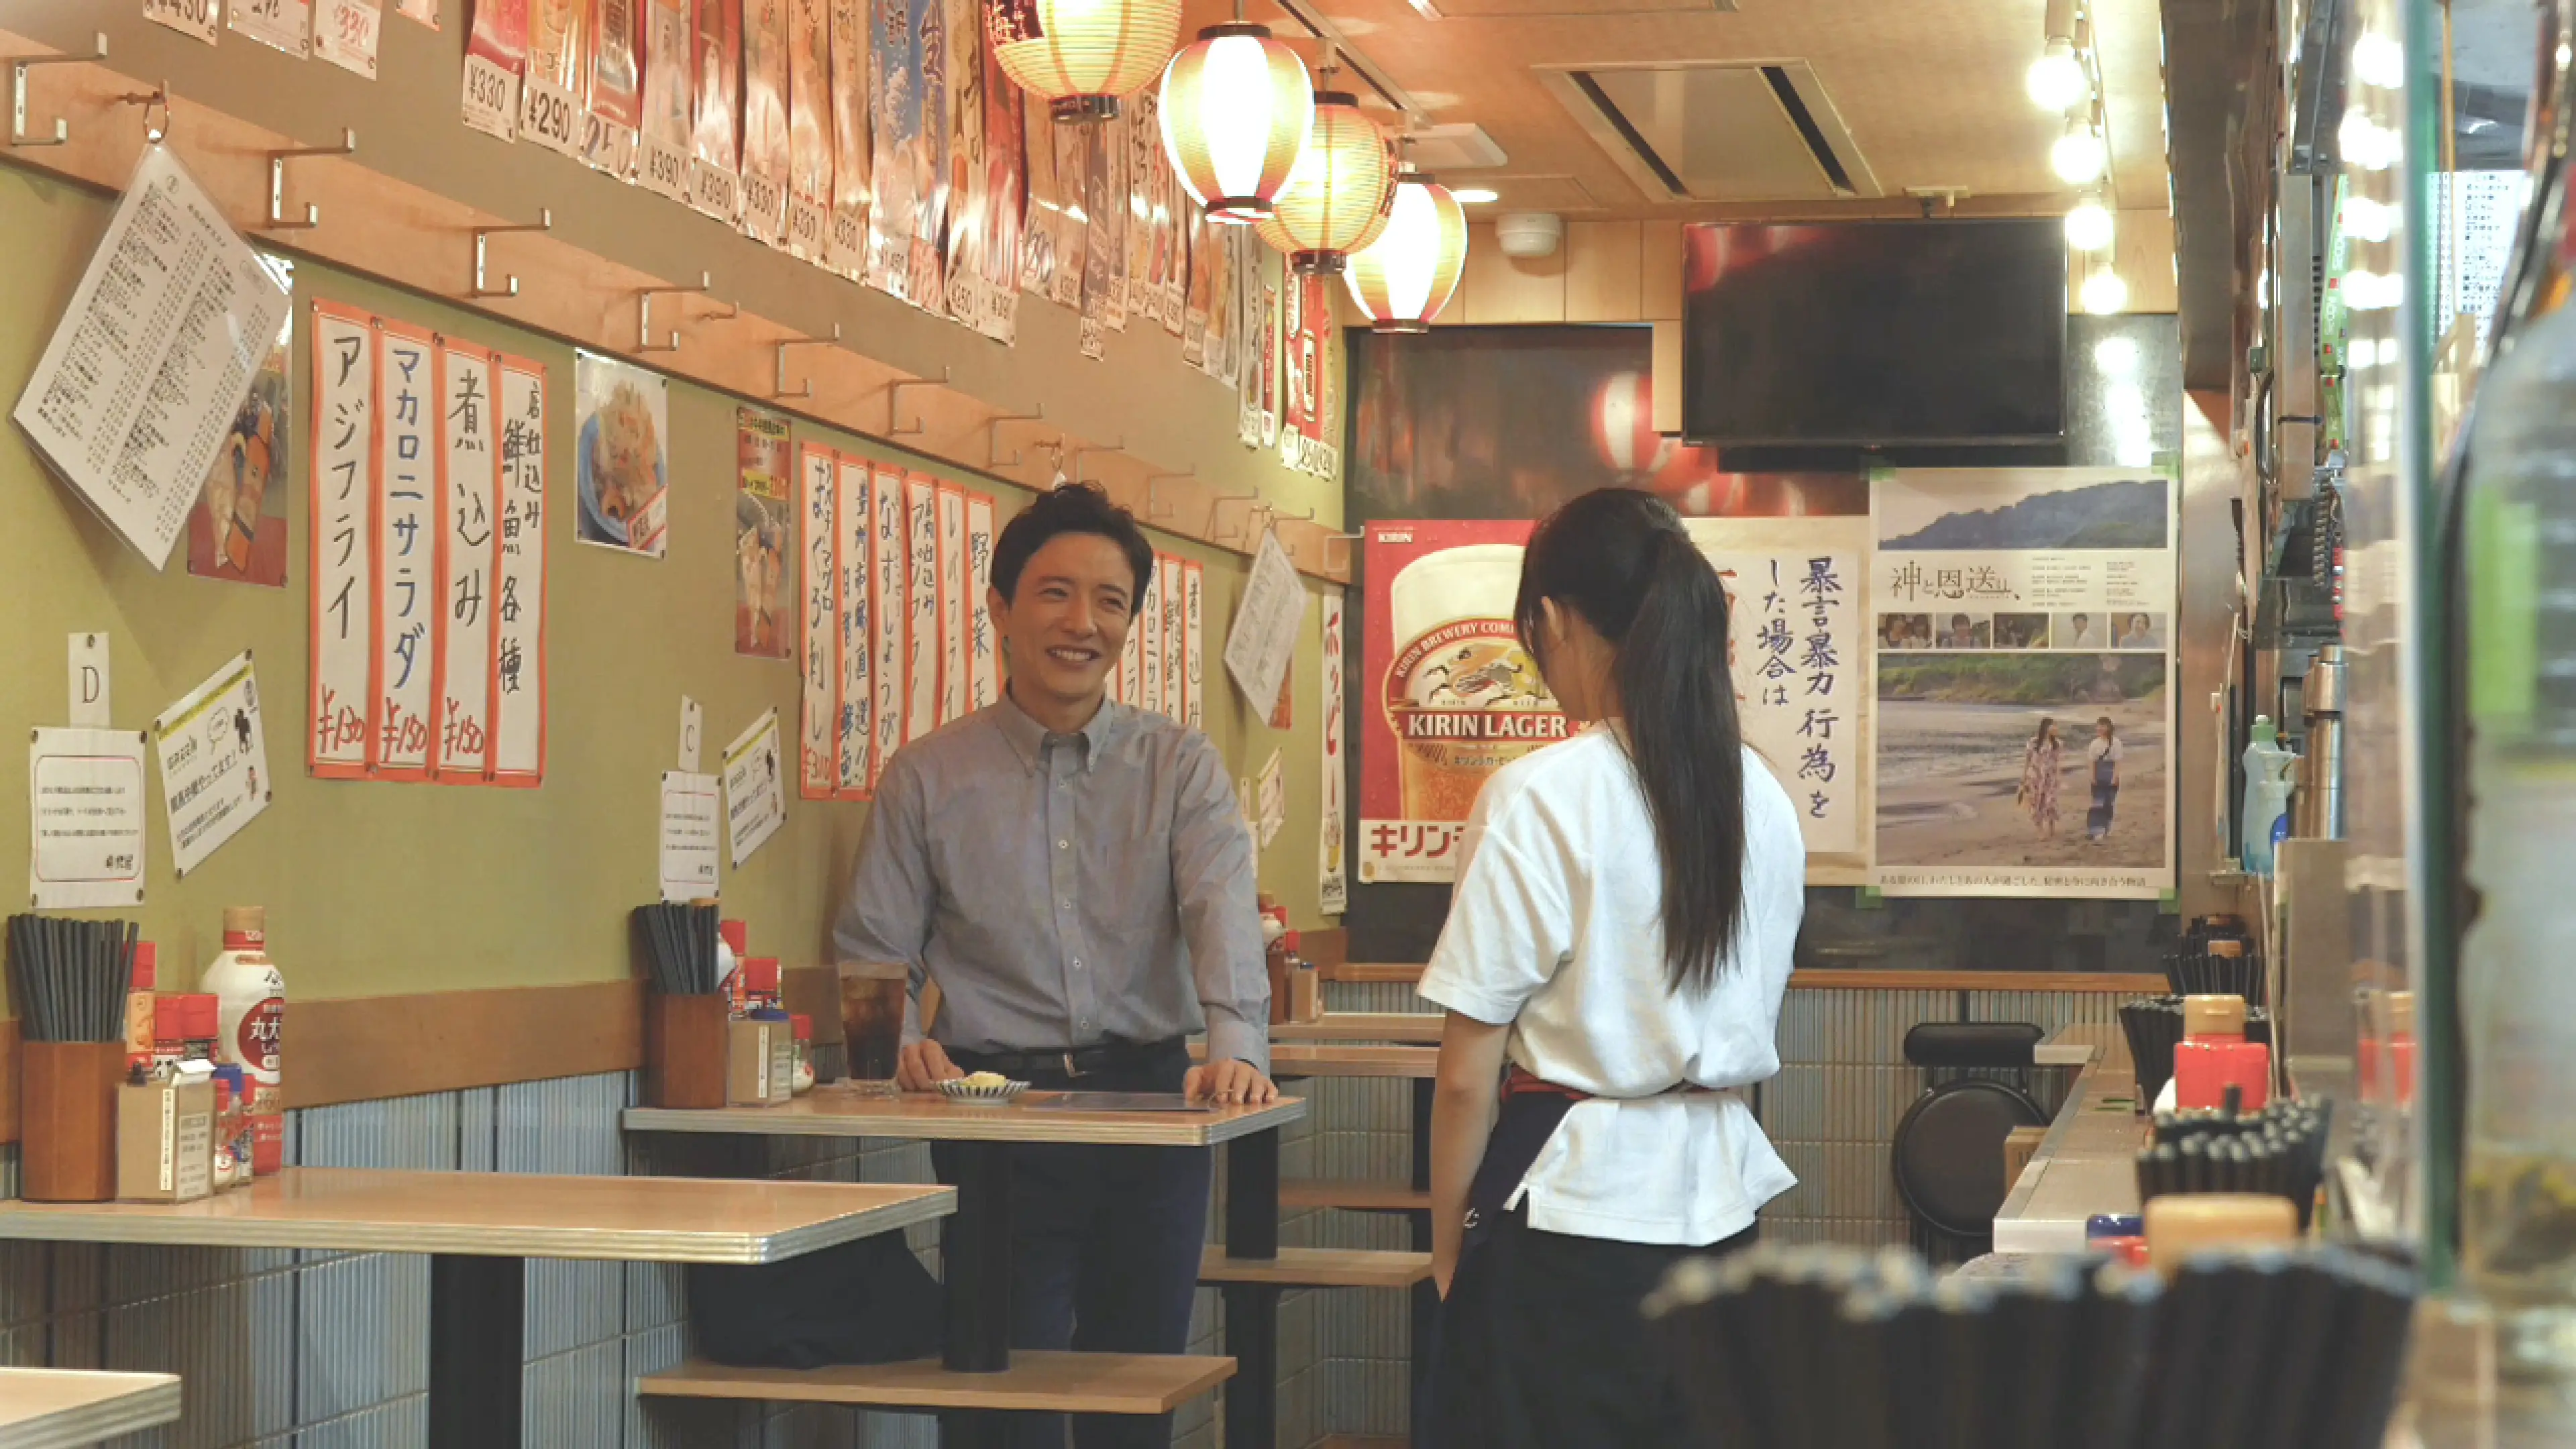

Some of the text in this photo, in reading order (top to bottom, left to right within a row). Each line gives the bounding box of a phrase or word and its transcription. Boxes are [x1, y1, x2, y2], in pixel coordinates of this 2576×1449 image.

[470, 64, 505, 111] ¥330
[529, 87, 570, 144] ¥290
[327, 336, 365, 639] アジフライ
[447, 368, 492, 627] 煮込み
[389, 348, 426, 689] マカロニサラダ
[499, 418, 521, 696] 鮮魚各種
[1420, 622, 1478, 651] BREWERY
[1756, 559, 1796, 706] した場合は
[82, 666, 99, 704] D
[1796, 556, 1844, 818] 暴言暴力行為を
[686, 724, 695, 753] C
[1409, 714, 1567, 738] KIRIN LAGER
[1371, 824, 1466, 859] キリン
